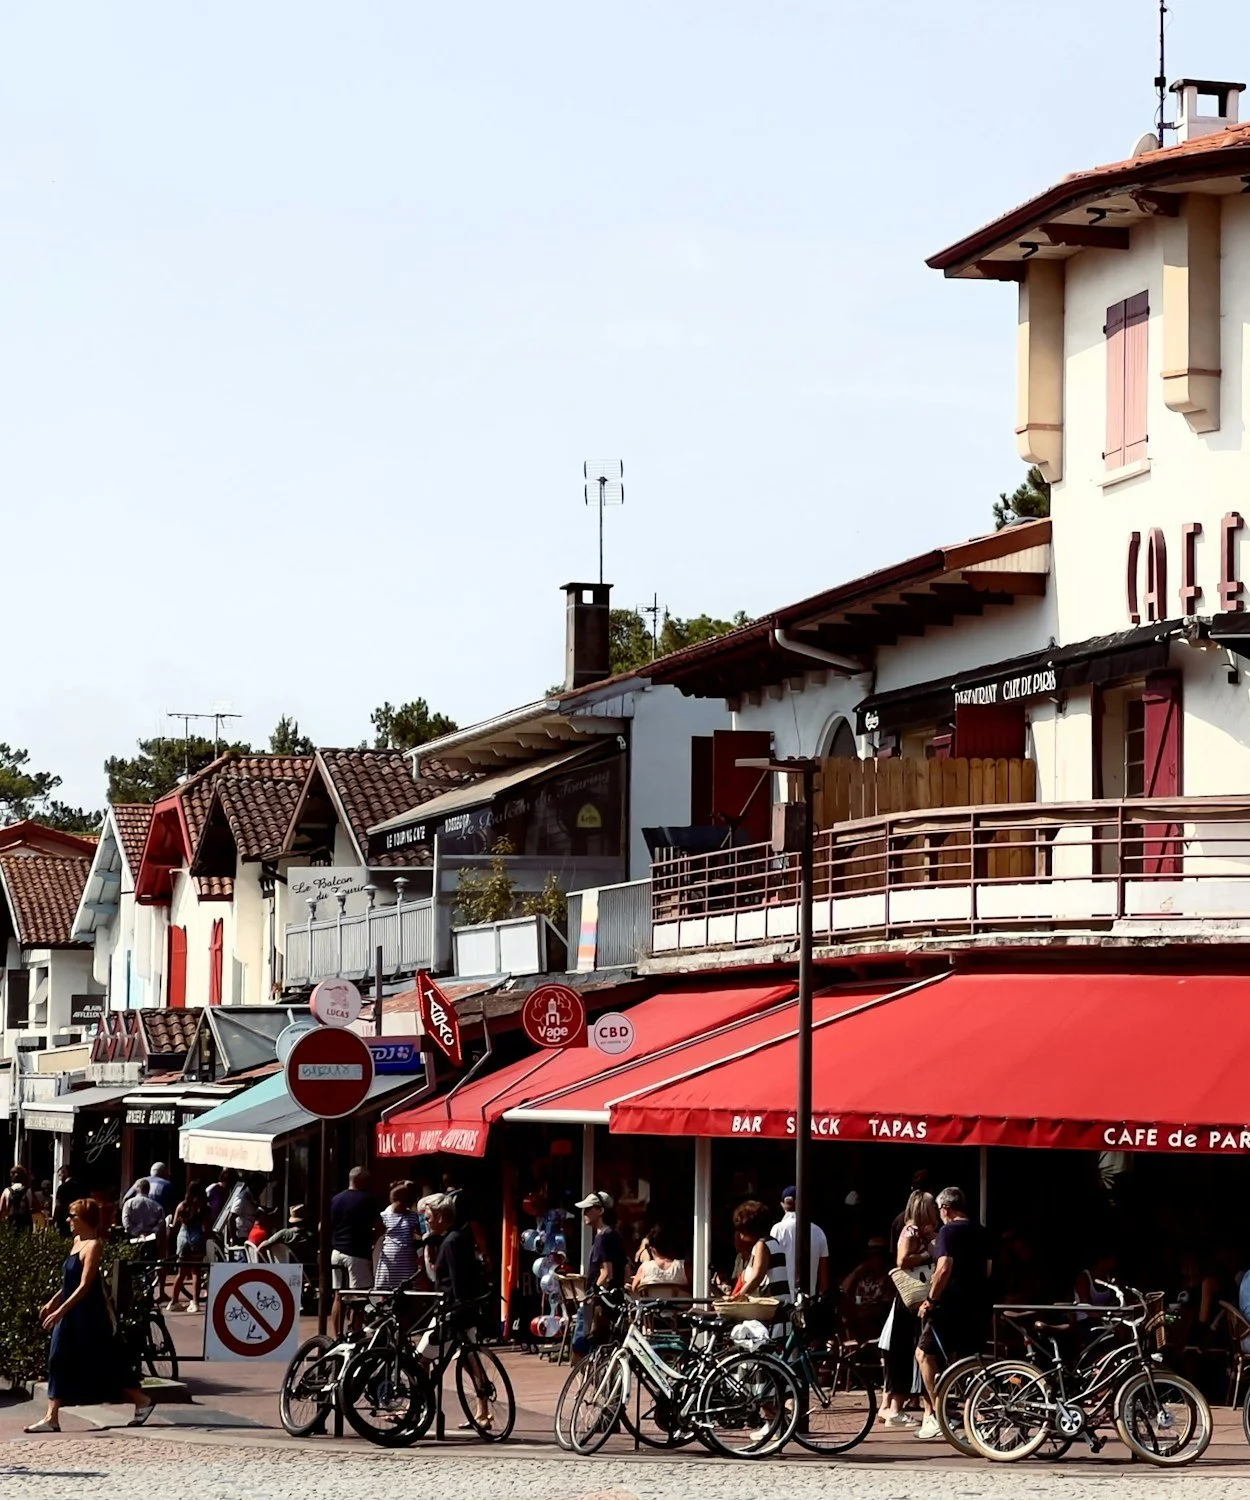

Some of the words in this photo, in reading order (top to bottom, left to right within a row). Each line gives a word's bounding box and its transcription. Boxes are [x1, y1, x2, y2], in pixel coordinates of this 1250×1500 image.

[313, 875, 354, 889] Balcon
[326, 1008, 350, 1019] LUCAS
[423, 989, 455, 1046] TABAC
[538, 1026, 569, 1040] Vape
[599, 1026, 629, 1038] CBD
[731, 1115, 762, 1133] BAR
[786, 1115, 841, 1136] SACK
[868, 1119, 928, 1139] TAPAS
[1103, 1127, 1158, 1146] CAFE
[1167, 1129, 1198, 1148] de
